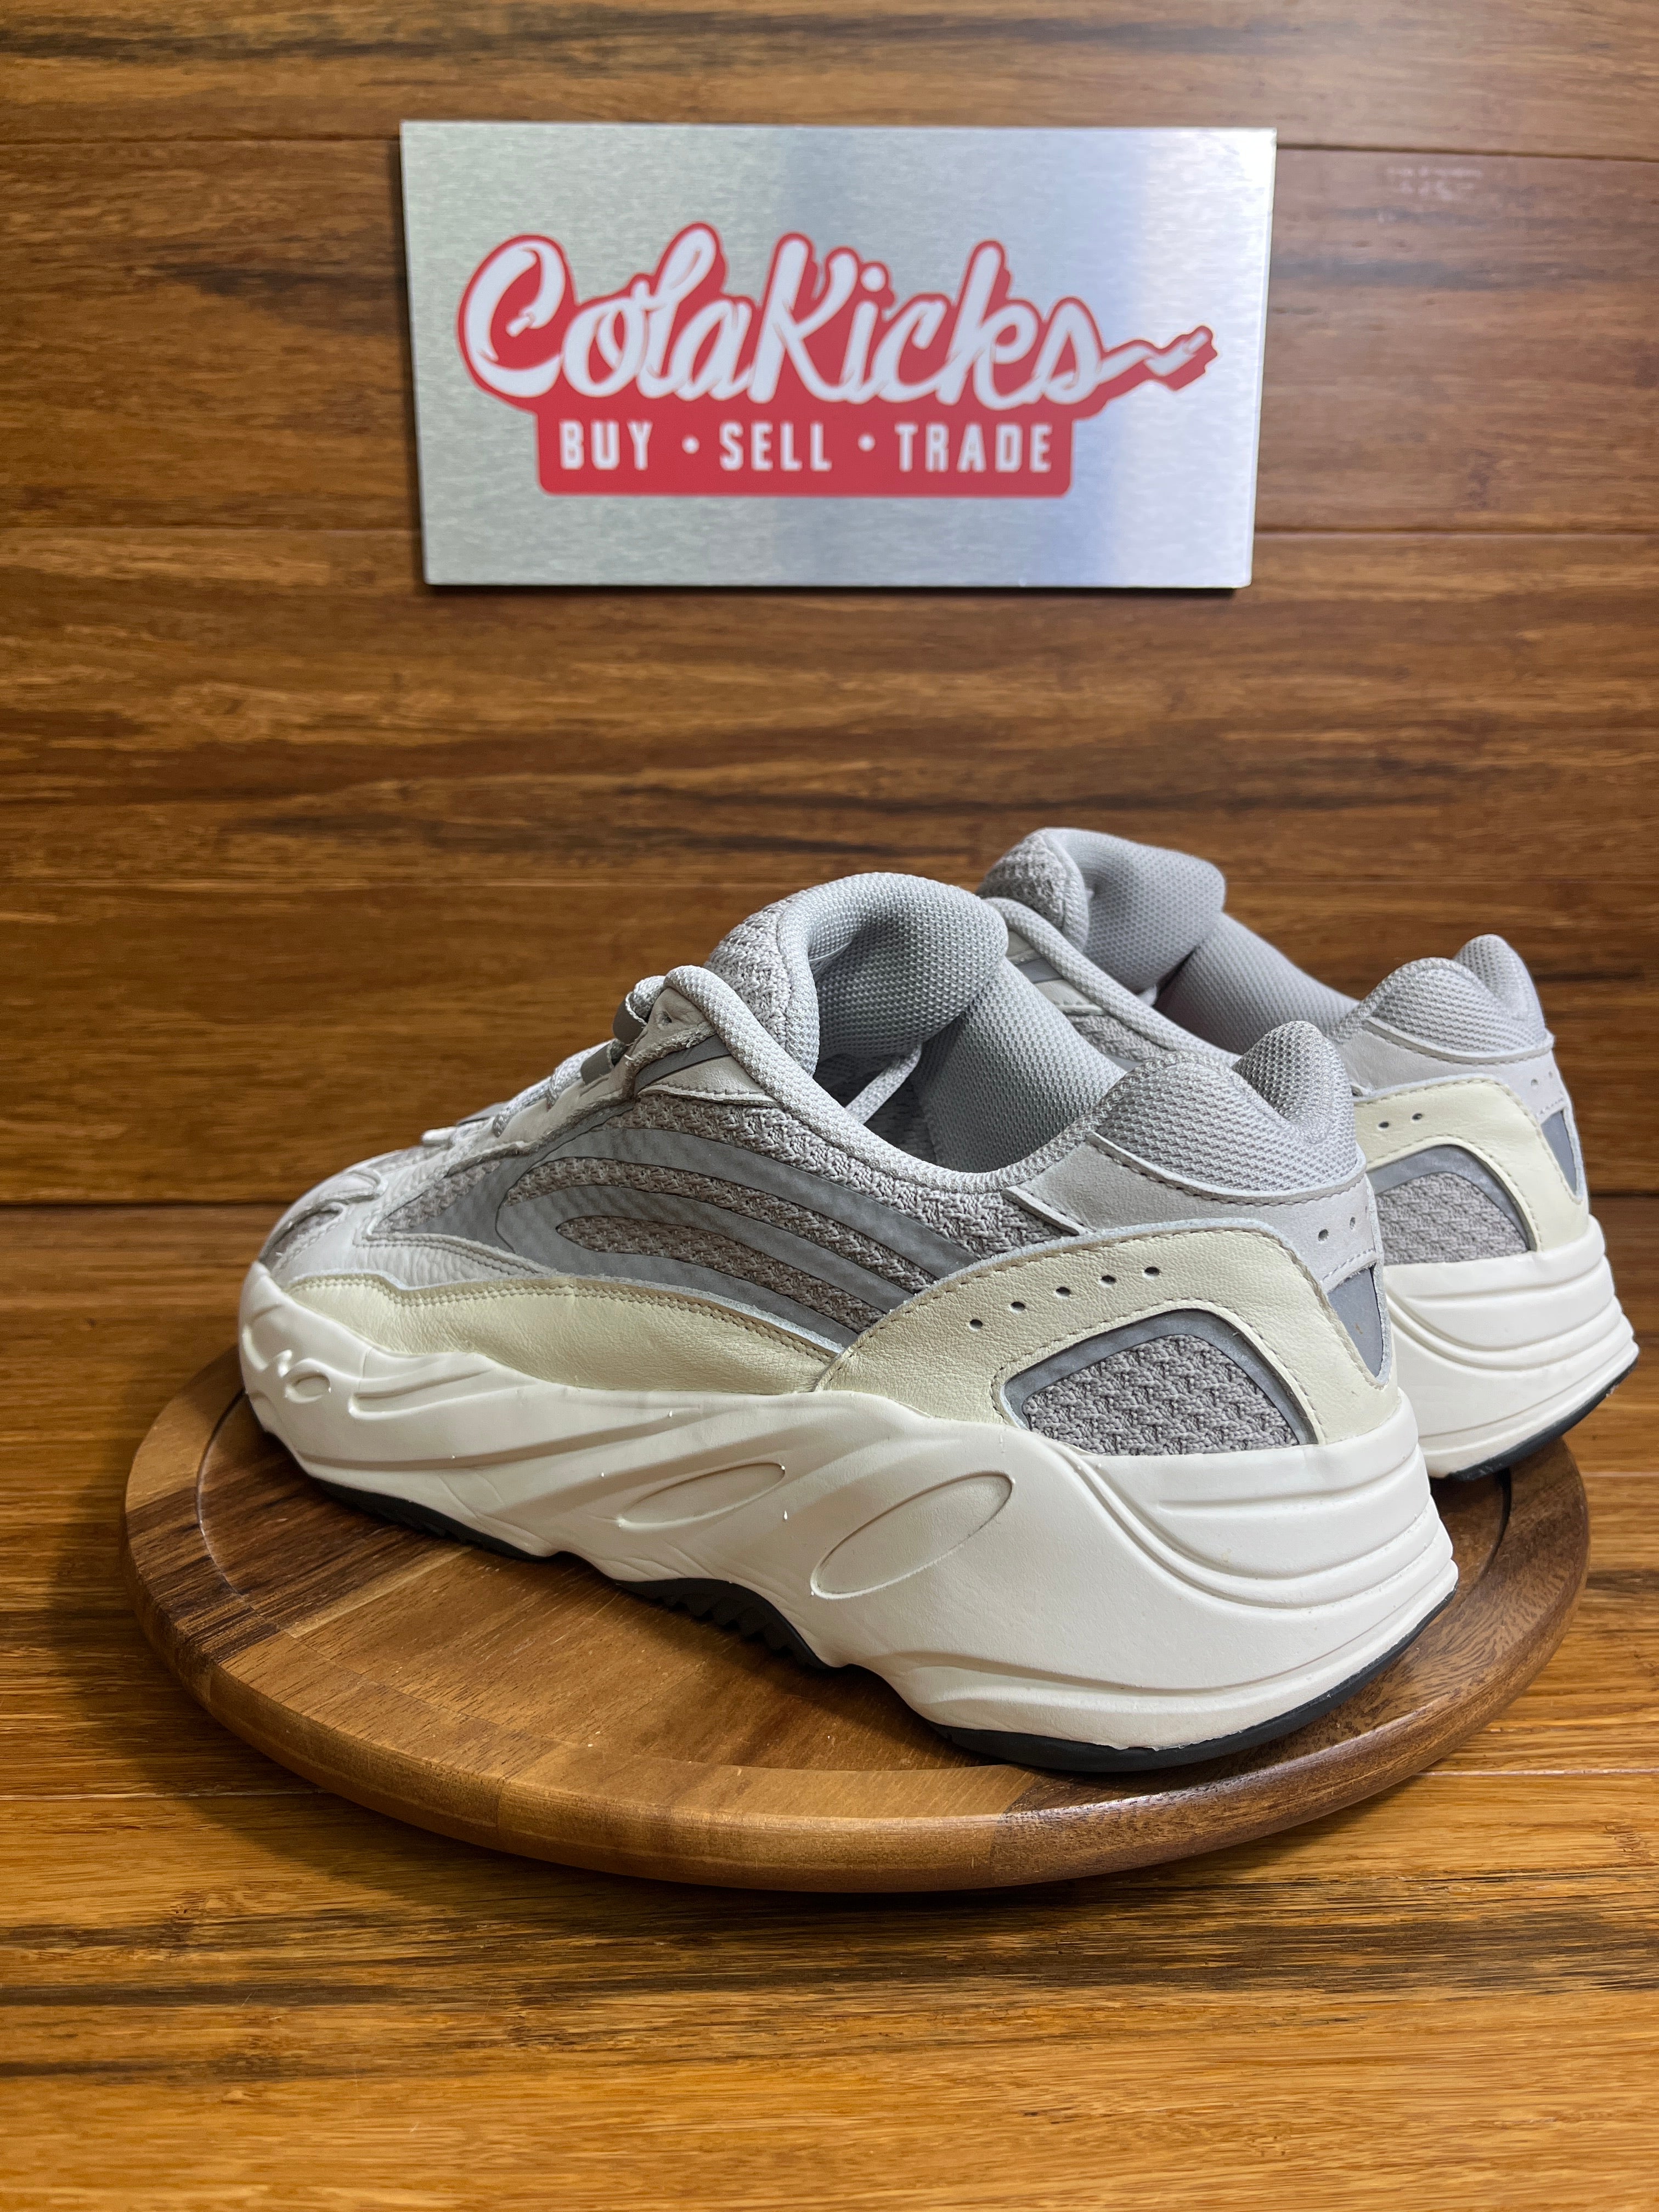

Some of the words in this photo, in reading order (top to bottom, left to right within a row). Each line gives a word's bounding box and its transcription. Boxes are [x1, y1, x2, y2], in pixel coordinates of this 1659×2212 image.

[461, 223, 1214, 410] ColaKicks
[560, 421, 653, 470] BUY
[720, 422, 832, 471] SELL
[896, 423, 1052, 473] TRADE
